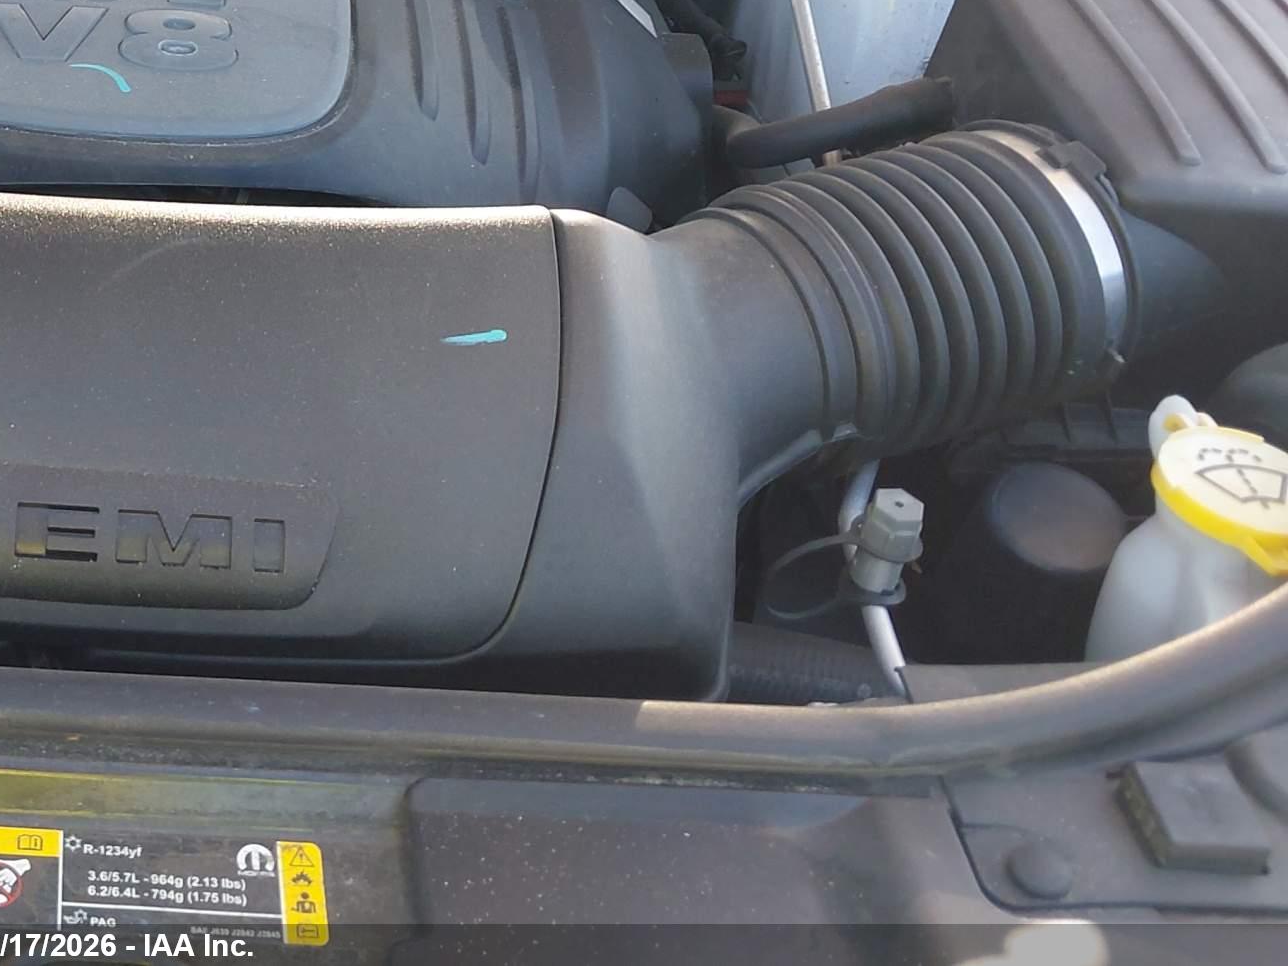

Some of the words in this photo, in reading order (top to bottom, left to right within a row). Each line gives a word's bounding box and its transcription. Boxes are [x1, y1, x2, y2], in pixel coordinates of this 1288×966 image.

[82, 843, 143, 858] R-1234yf
[87, 870, 140, 884] 3.6/5.7L
[151, 875, 183, 888] 964g
[187, 875, 218, 889] (2.13
[222, 877, 246, 891] lbs)
[87, 885, 140, 899] 6.2/6.4L
[152, 890, 184, 904] 794g
[187, 890, 219, 904] (1.75
[222, 893, 247, 906] lbs)
[89, 916, 117, 928] PAG
